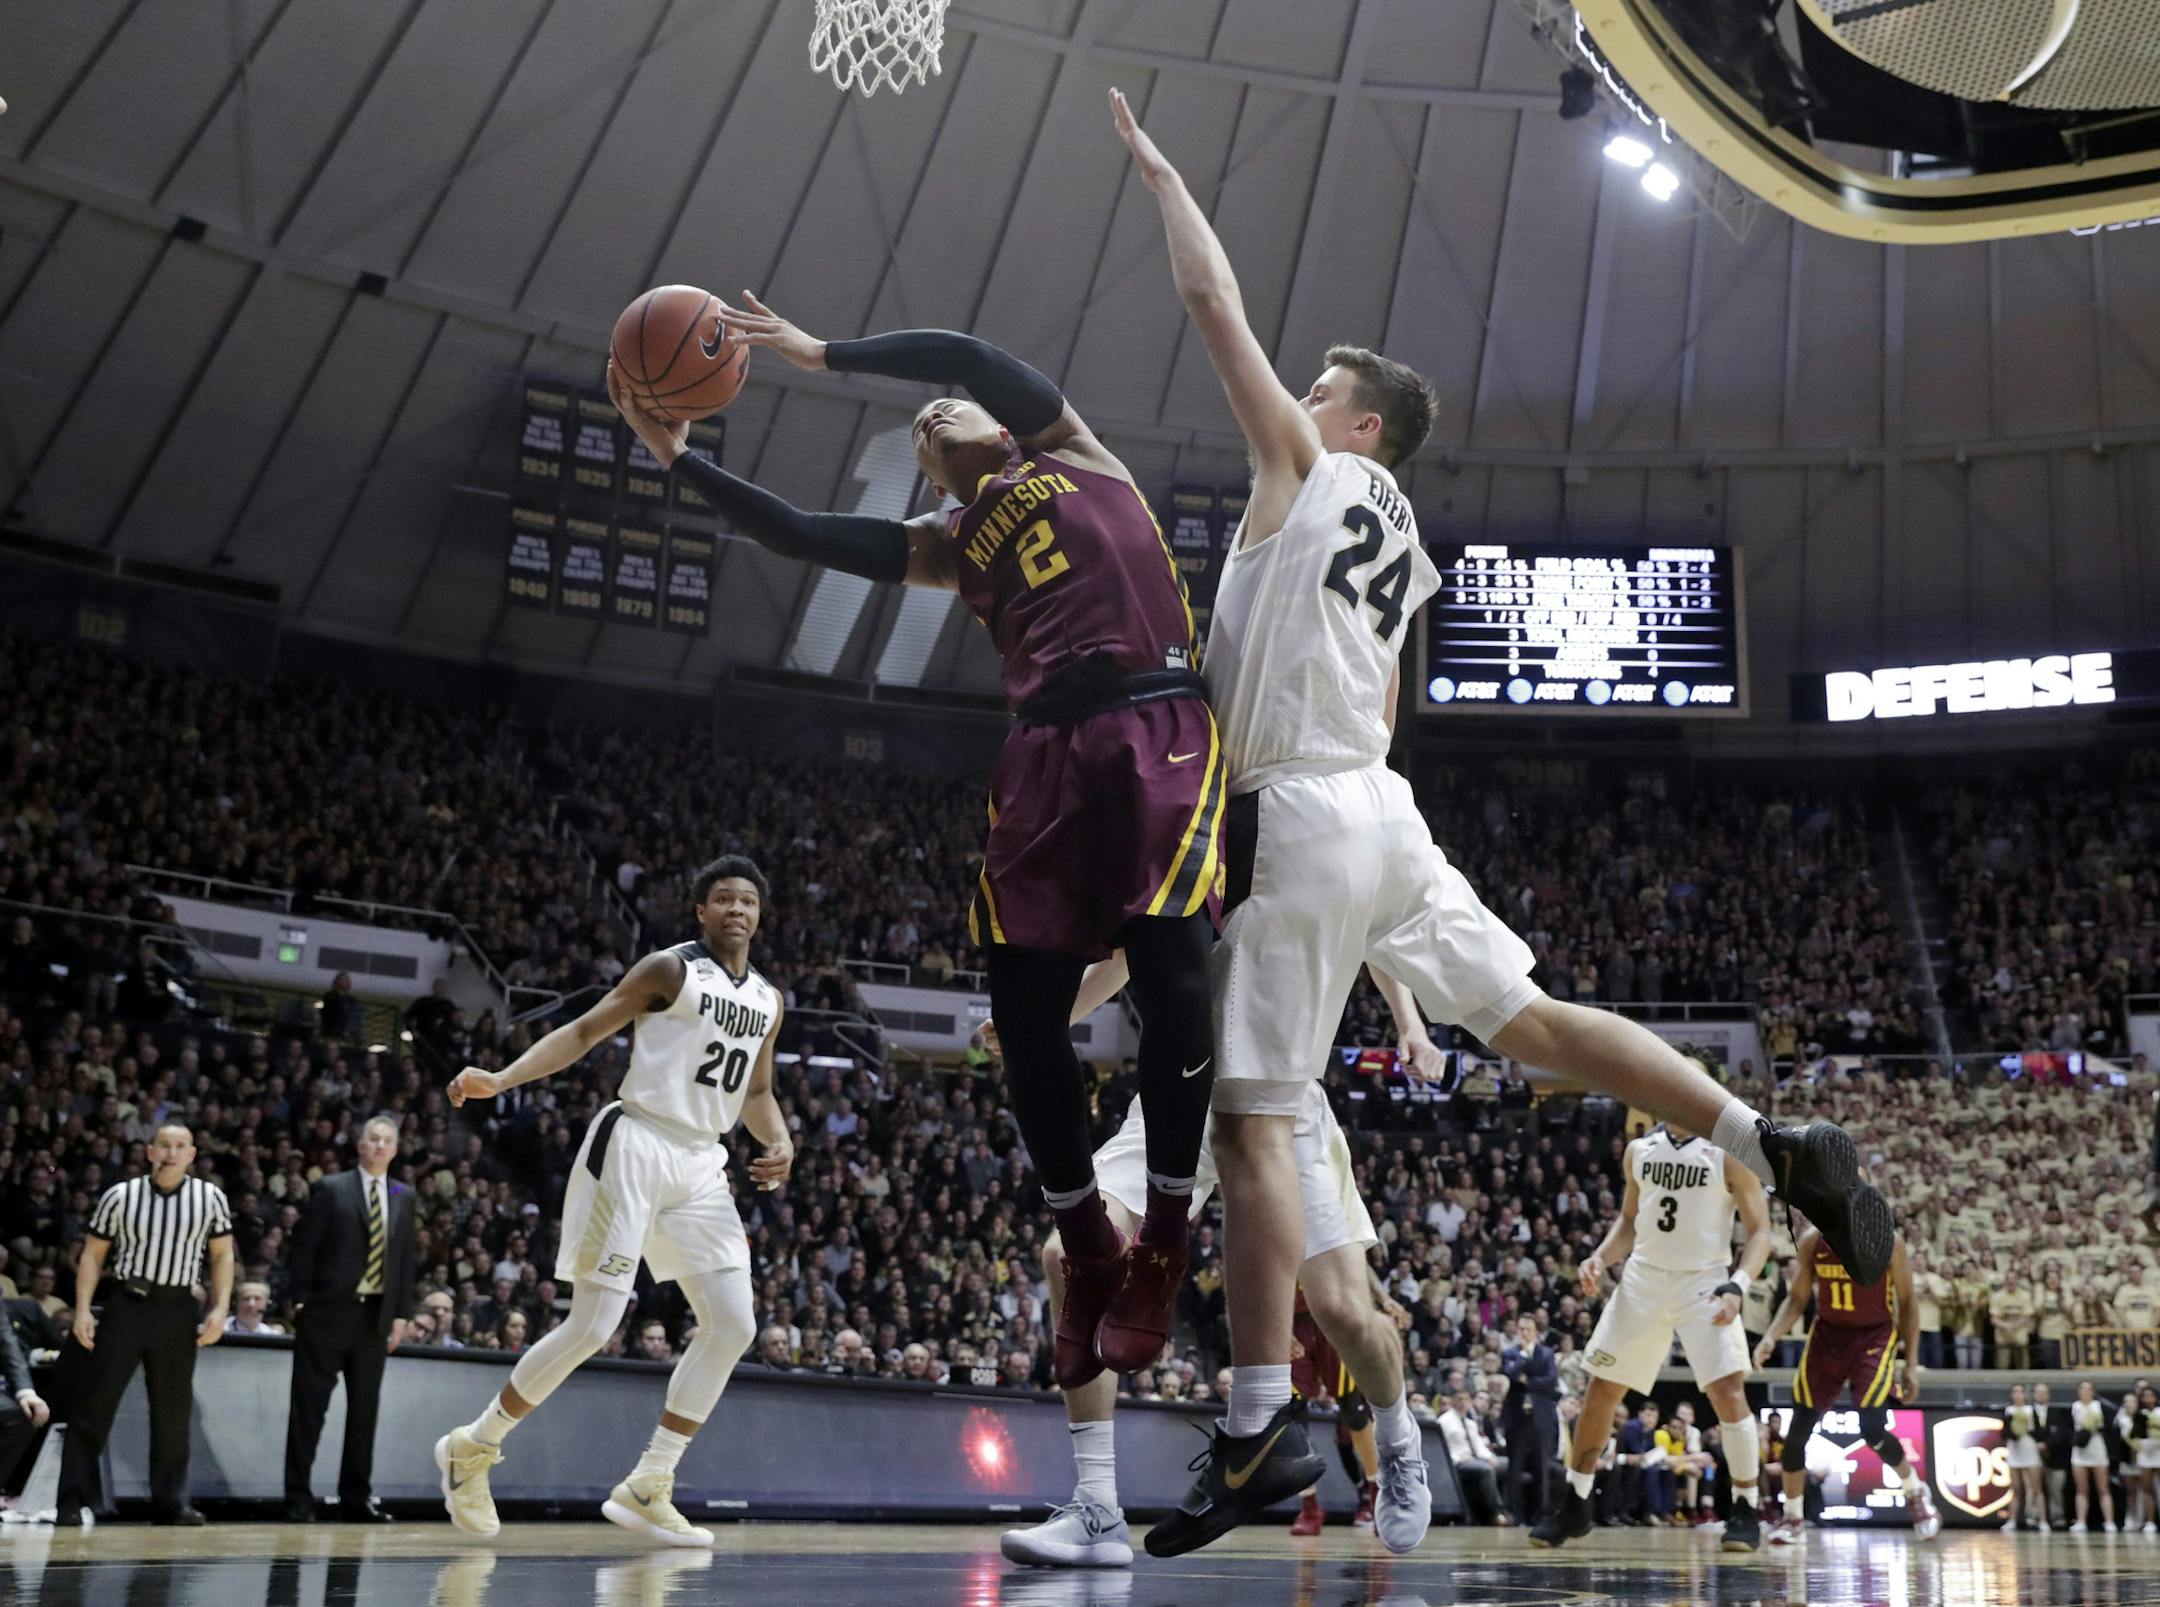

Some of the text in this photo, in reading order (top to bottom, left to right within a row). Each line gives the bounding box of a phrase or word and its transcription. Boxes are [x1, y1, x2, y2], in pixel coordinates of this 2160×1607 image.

[965, 473, 1079, 572] MINNESOTA
[1015, 520, 1071, 590] 2
[1324, 504, 1412, 642] 24
[1825, 652, 2116, 721] DEFENSE
[698, 992, 768, 1038] PURDUE
[695, 1040, 749, 1094] 20
[1642, 1162, 1709, 1190] PURDUE
[1657, 1196, 1678, 1233] 3
[1830, 1281, 1855, 1311] 11
[2065, 1333, 2160, 1366] DEFENS
